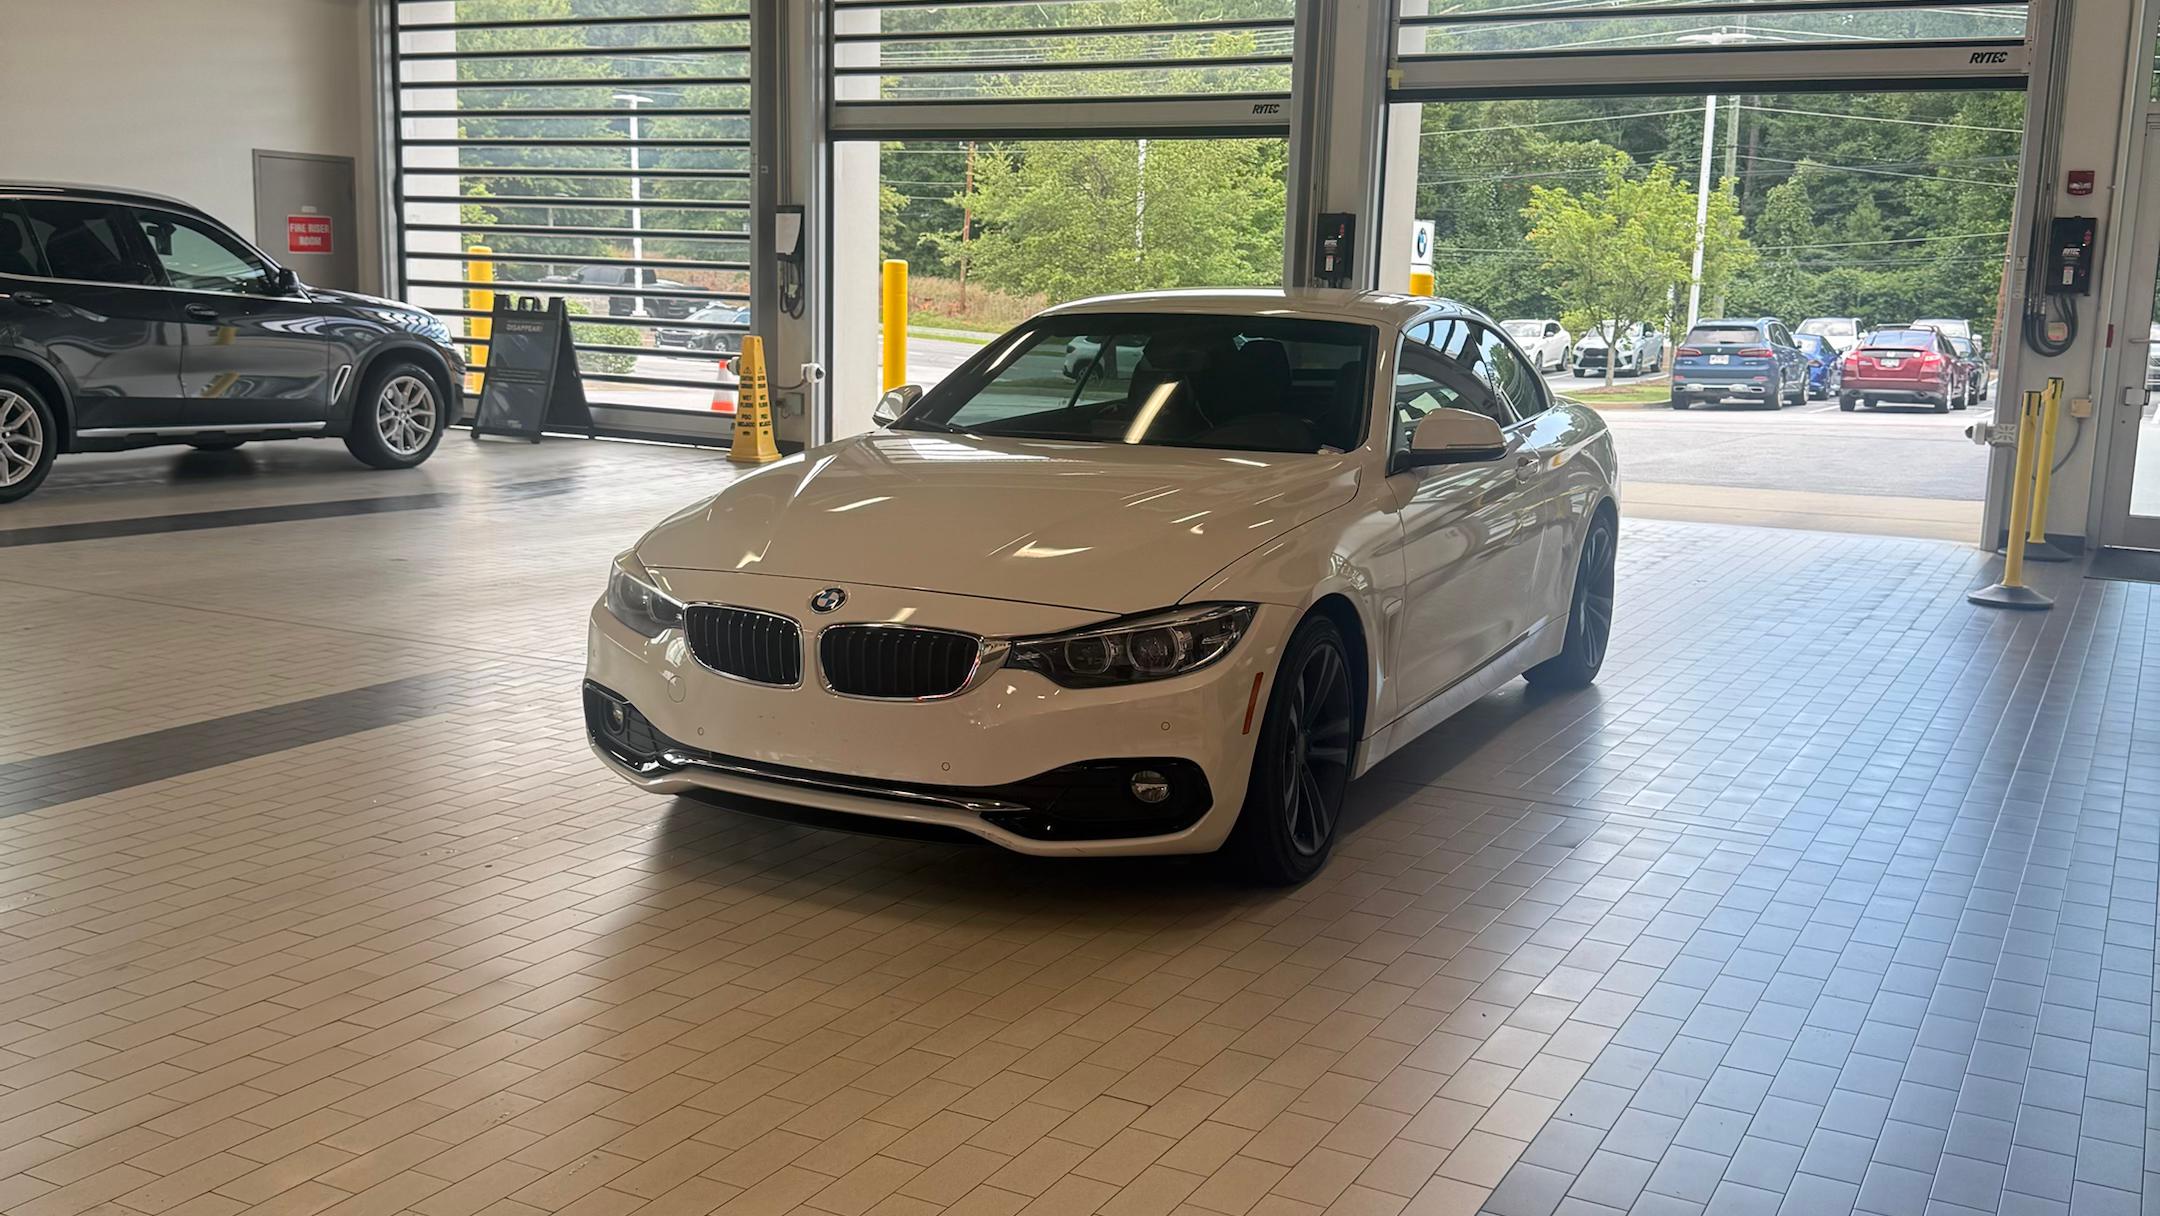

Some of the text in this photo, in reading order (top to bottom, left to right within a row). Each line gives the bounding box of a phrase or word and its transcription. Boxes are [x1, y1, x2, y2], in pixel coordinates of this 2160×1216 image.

[1969, 51, 2008, 64] RYTEC
[1252, 103, 1280, 114] RYTEC
[290, 223, 305, 233] FIRE
